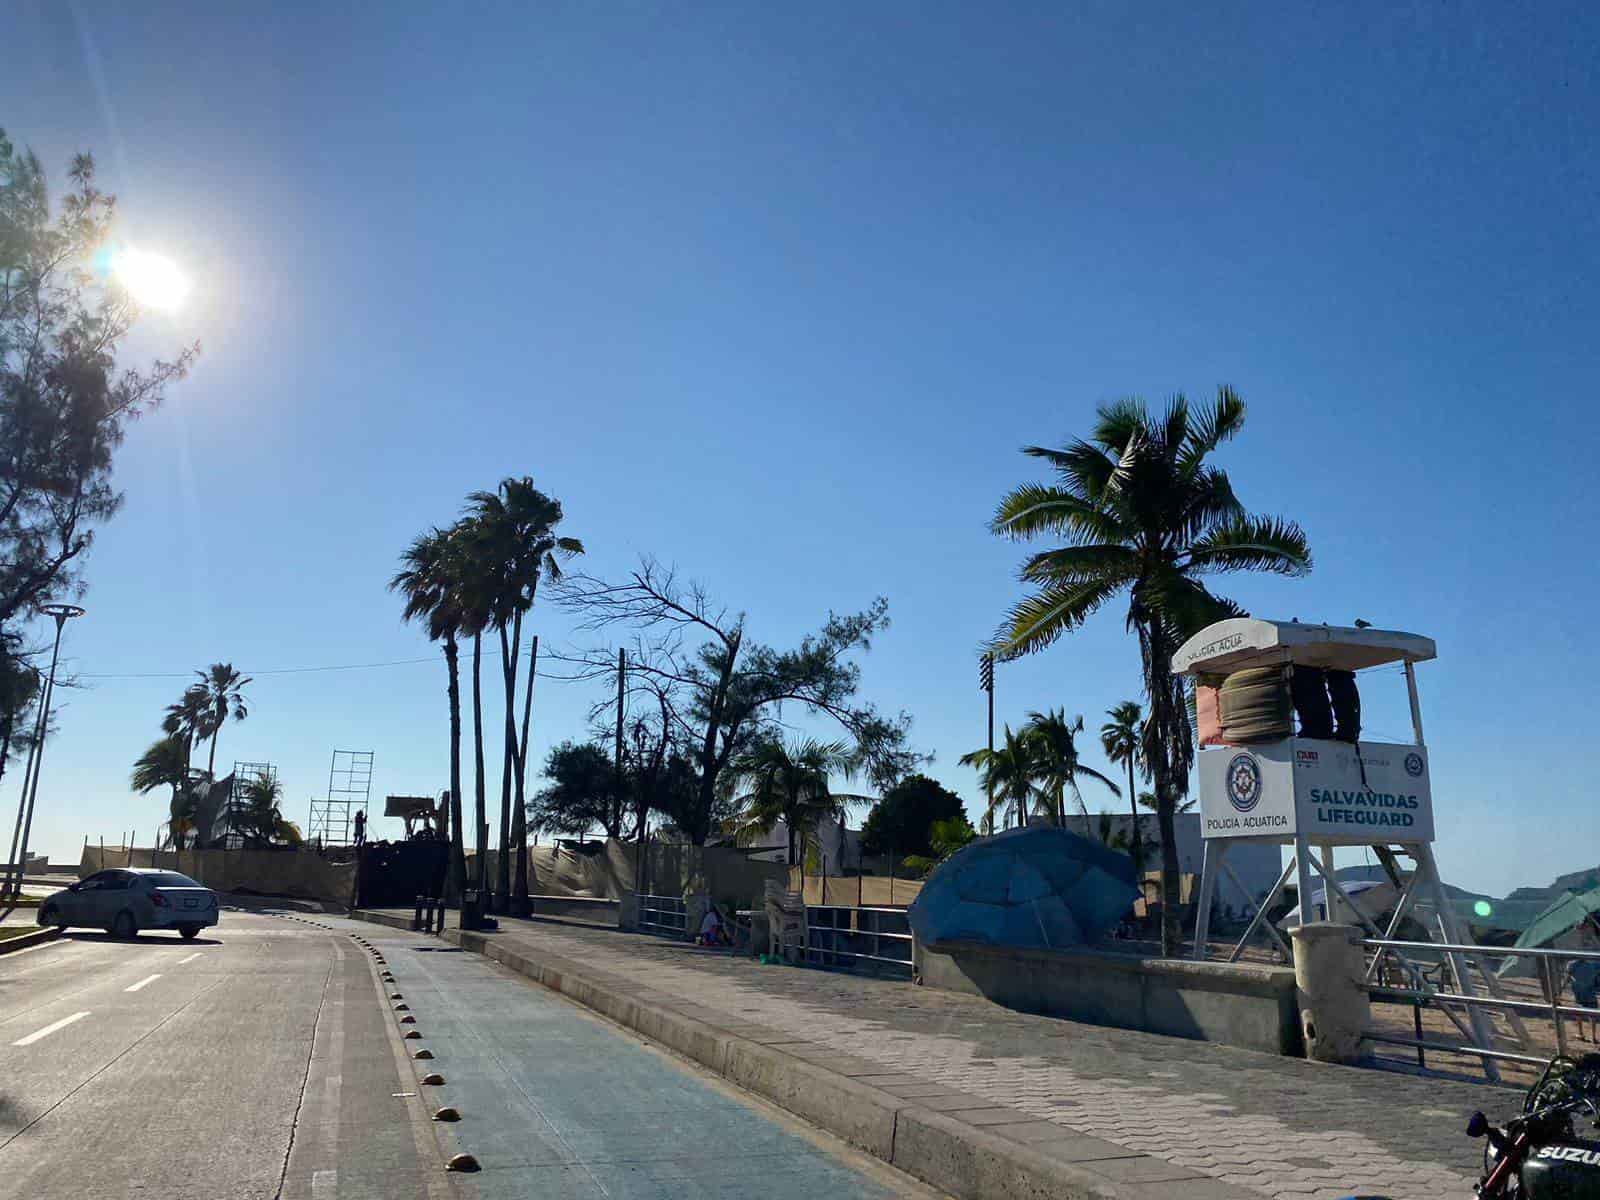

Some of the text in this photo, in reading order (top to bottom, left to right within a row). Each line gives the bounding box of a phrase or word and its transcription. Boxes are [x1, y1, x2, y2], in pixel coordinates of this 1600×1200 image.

[1310, 788, 1419, 809] SALVAVIDAS
[1207, 818, 1240, 830] POLICIA
[1317, 807, 1414, 827] LIFEGUARD
